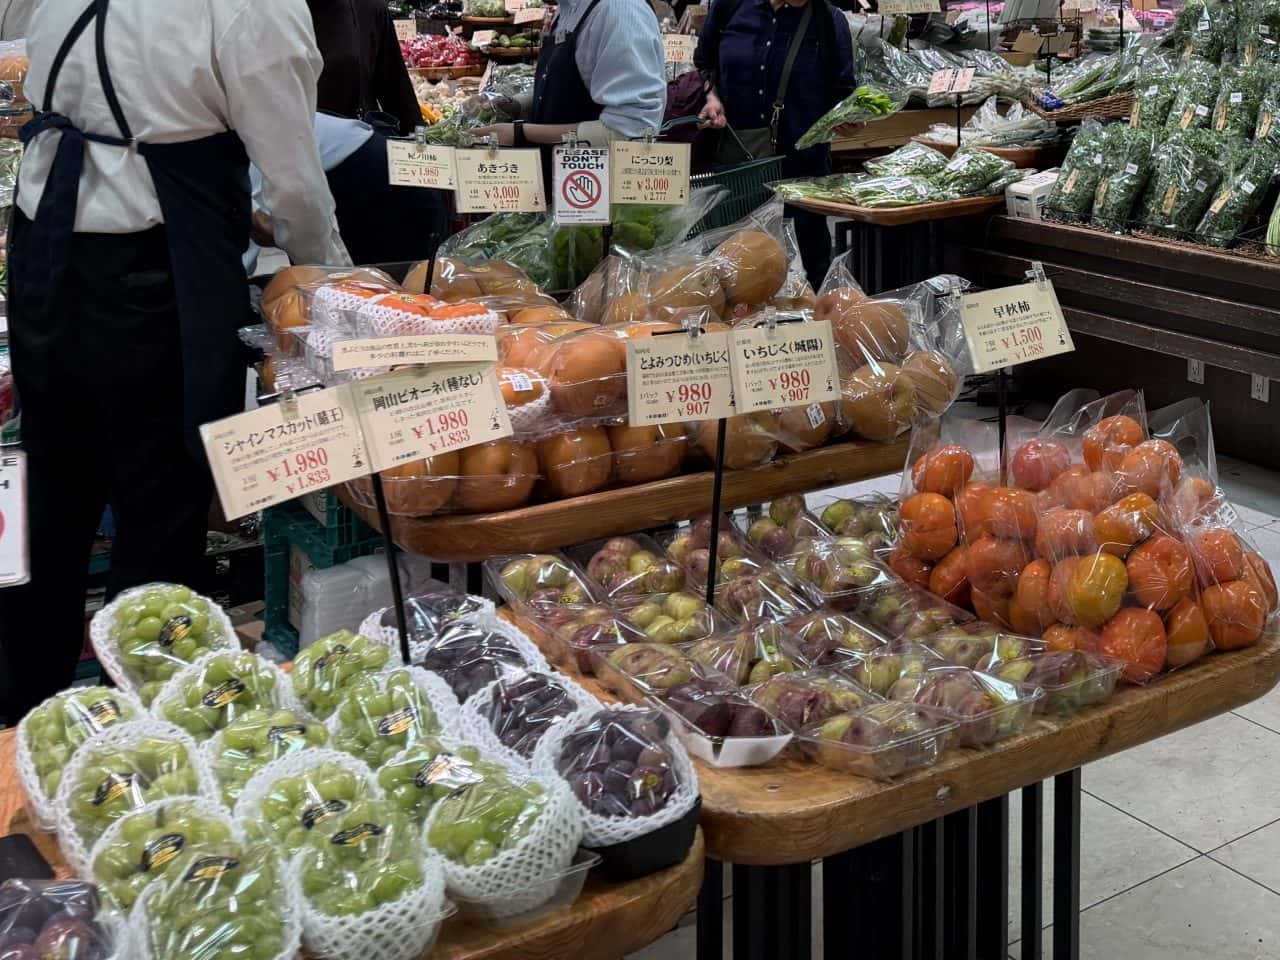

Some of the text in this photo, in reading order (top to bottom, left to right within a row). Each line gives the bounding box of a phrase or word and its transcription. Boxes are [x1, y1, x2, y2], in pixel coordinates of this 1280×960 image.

[478, 162, 519, 174] あきづき
[560, 162, 604, 170] TOUCH
[632, 155, 674, 166] にっこり梨
[993, 300, 1030, 318] 早秋柿
[1001, 326, 1042, 349] ¥1,500
[744, 338, 824, 360] いちじく(城陽)
[768, 368, 810, 390] ¥980
[666, 382, 712, 402] ¥980
[781, 388, 809, 402] ¥907
[677, 402, 710, 416] ¥907
[224, 406, 344, 456] シャインマスカット(晴王)
[411, 408, 468, 439] ¥1,980
[266, 447, 329, 483] ¥1,980
